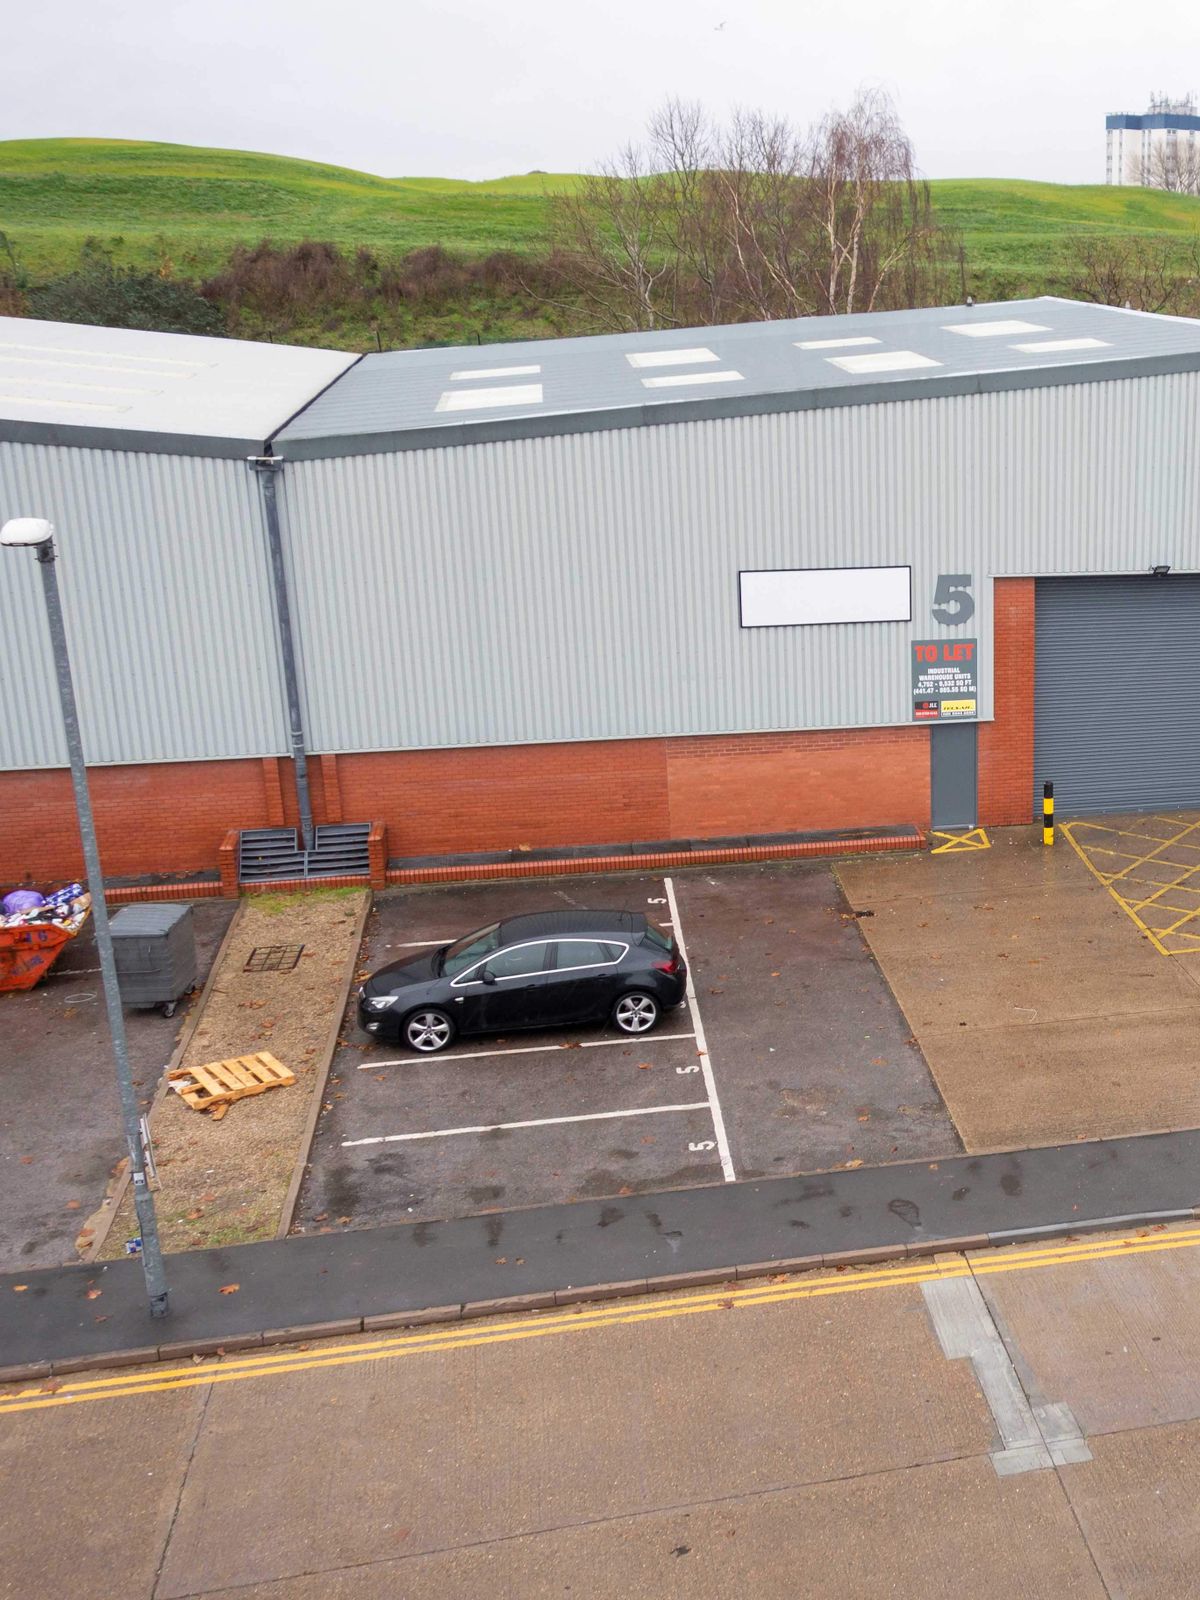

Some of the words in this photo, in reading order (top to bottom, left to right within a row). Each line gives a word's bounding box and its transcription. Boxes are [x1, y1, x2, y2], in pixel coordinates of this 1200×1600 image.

[931, 574, 975, 625] 5
[914, 644, 938, 662] TO
[943, 643, 975, 661] LET
[676, 1065, 700, 1075] 5
[688, 1140, 717, 1152] 5
